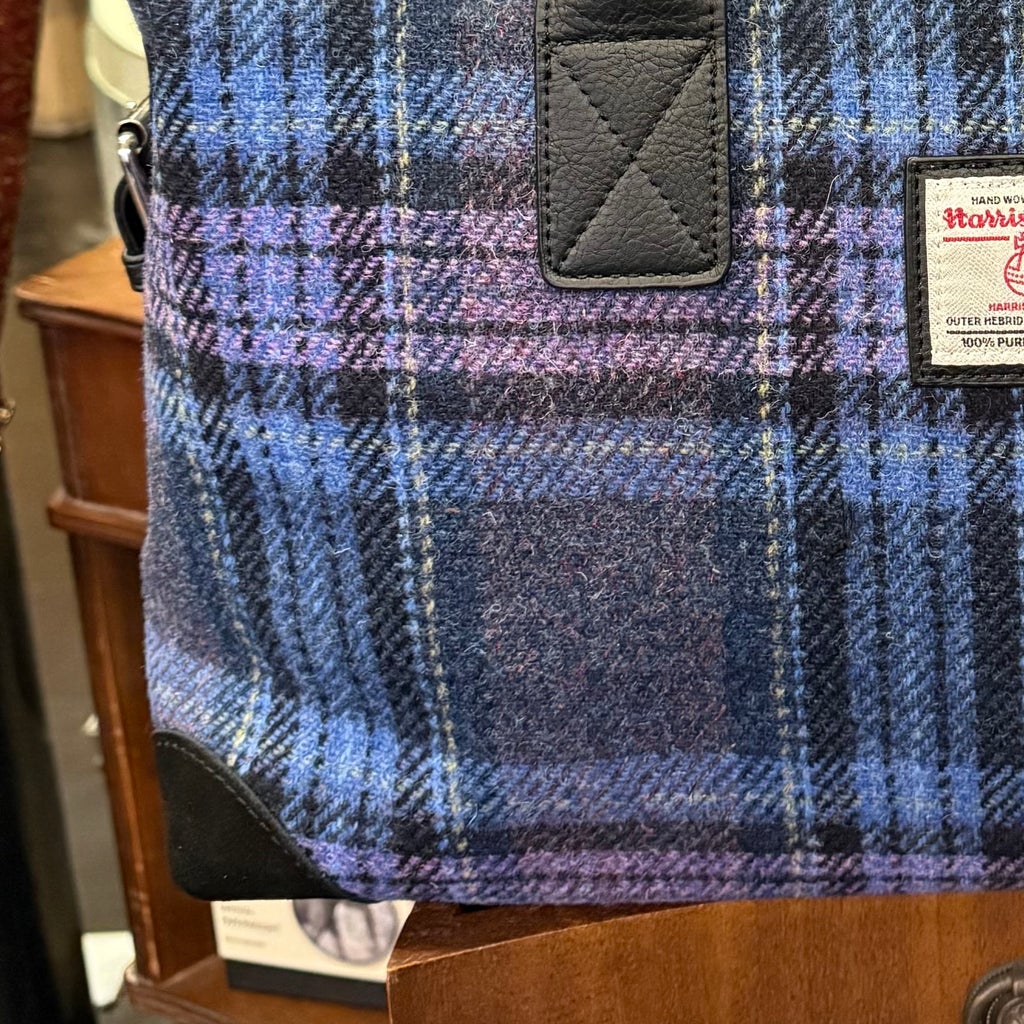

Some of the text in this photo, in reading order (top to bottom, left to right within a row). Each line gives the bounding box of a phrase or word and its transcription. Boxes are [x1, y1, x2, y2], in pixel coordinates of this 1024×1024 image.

[971, 195, 1001, 205] HAND
[946, 316, 981, 326] OUTER
[961, 337, 996, 348] 100%
